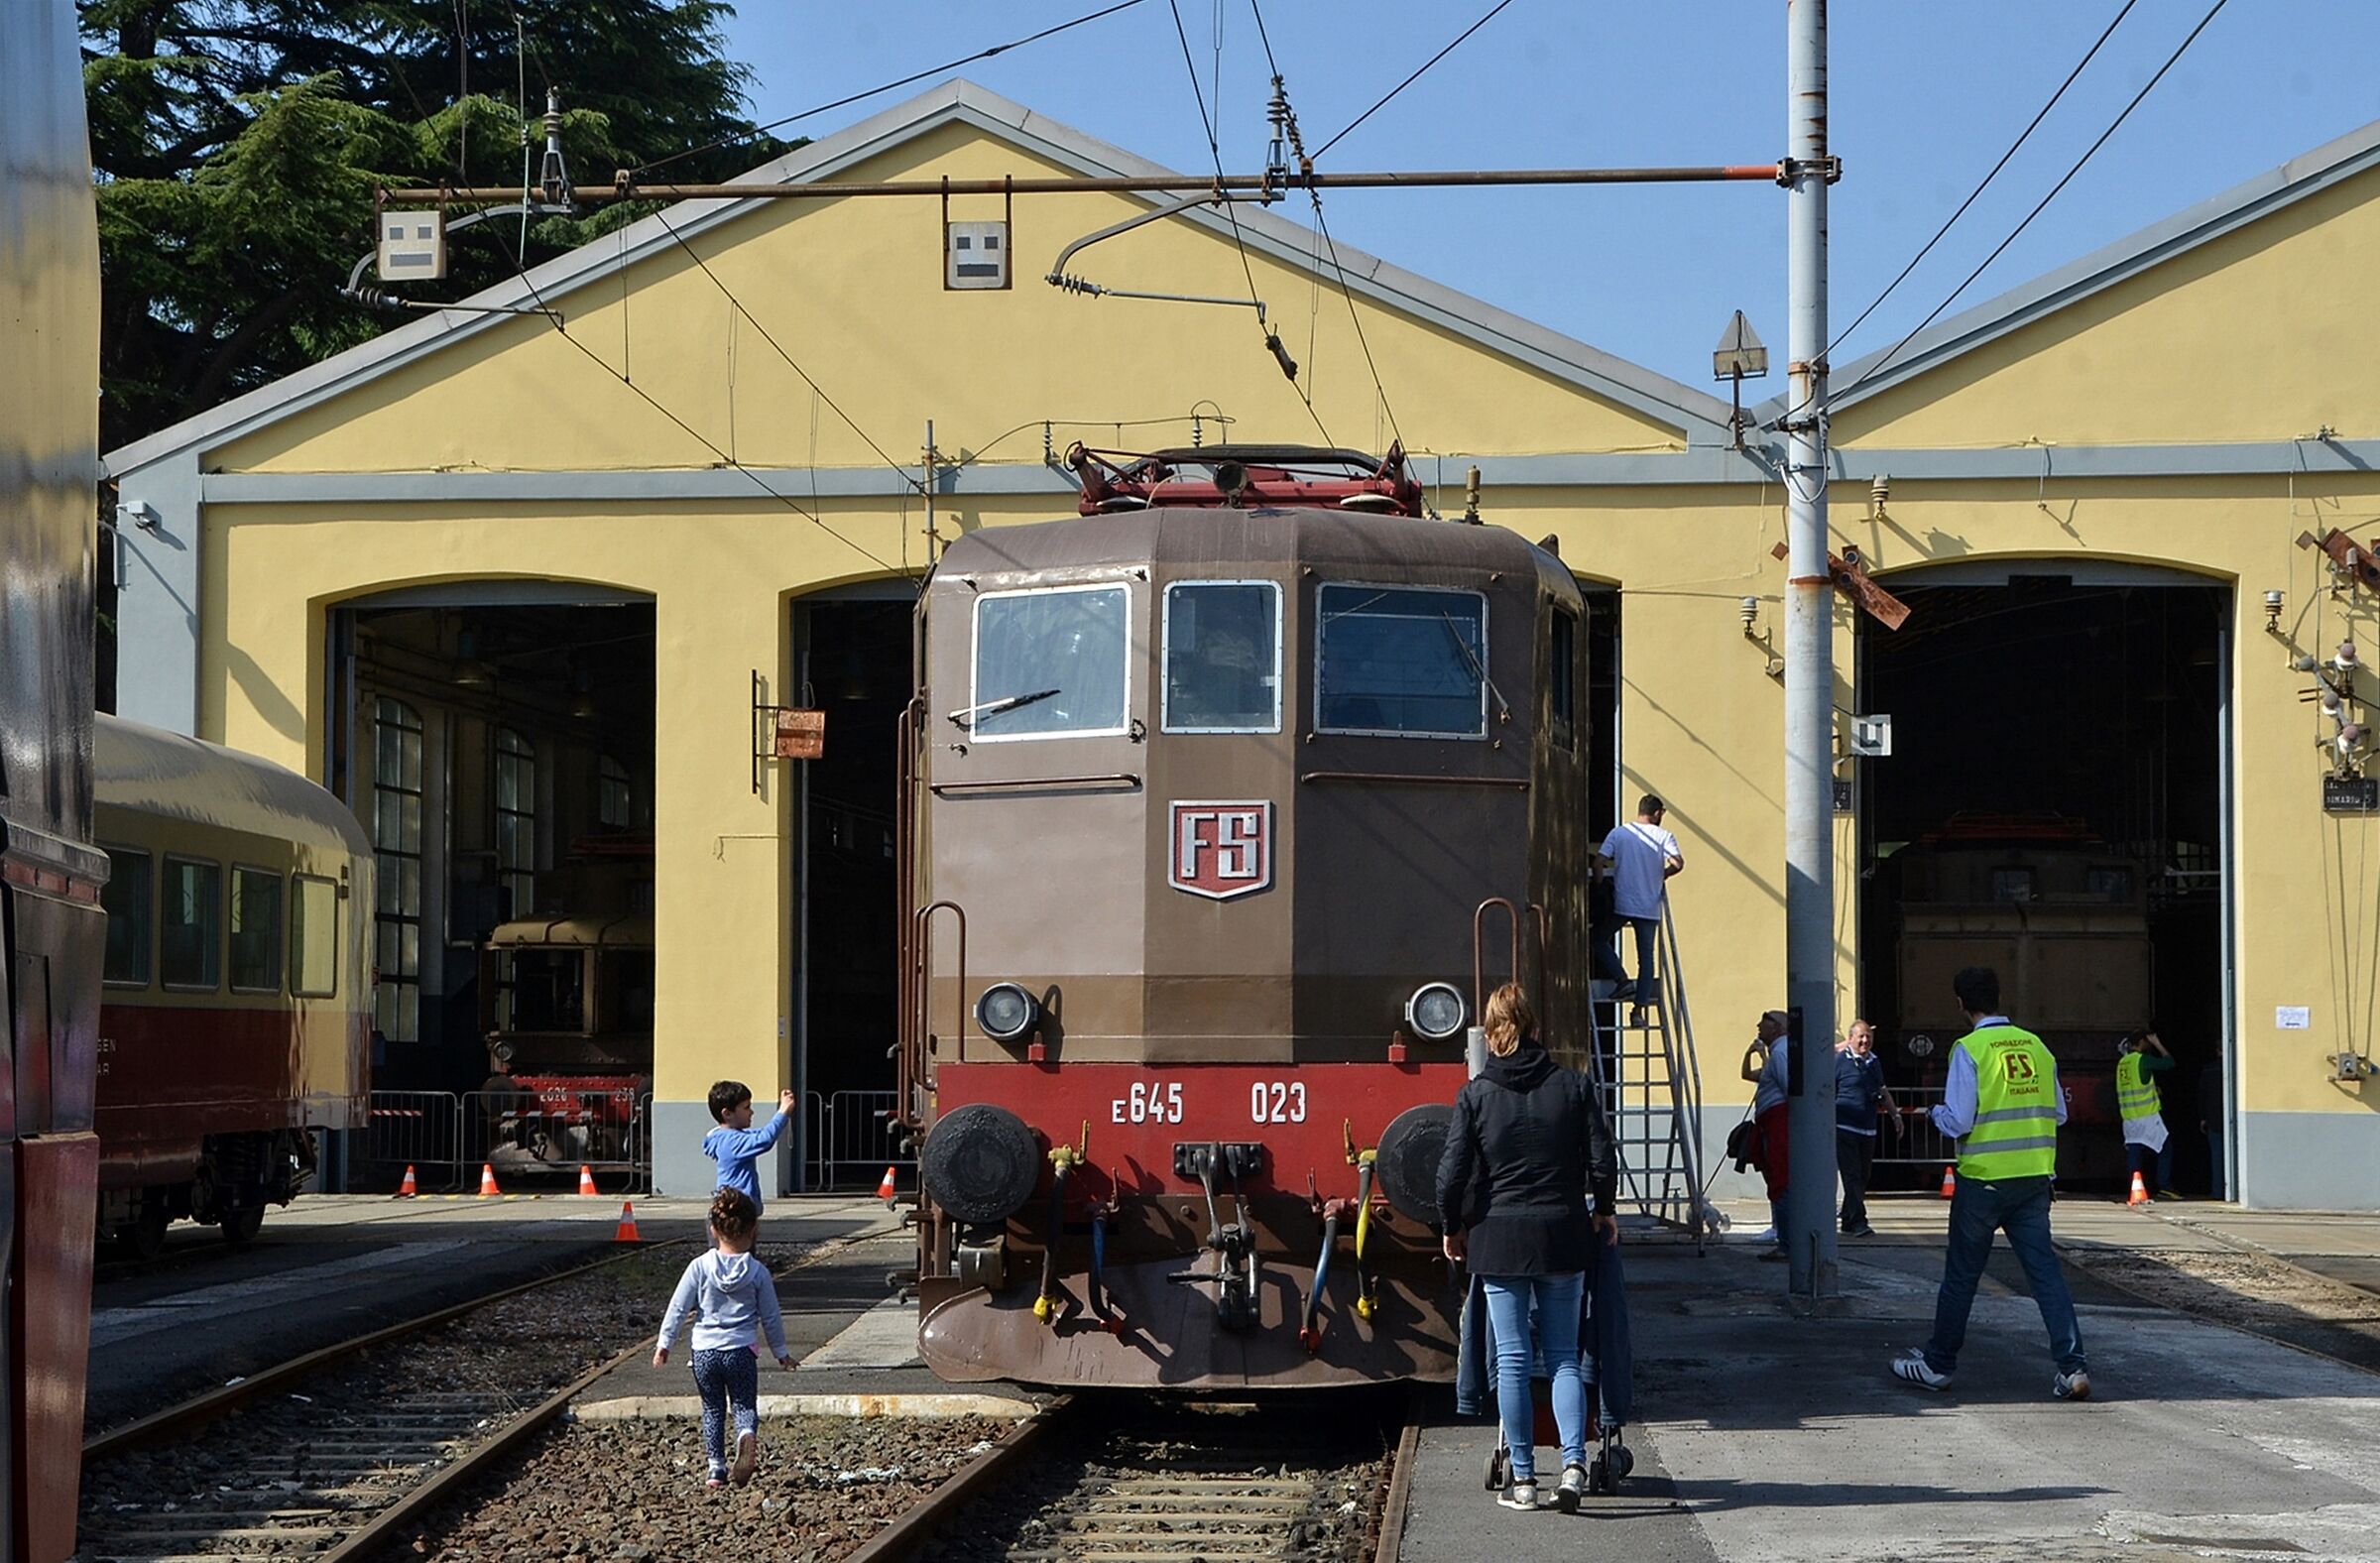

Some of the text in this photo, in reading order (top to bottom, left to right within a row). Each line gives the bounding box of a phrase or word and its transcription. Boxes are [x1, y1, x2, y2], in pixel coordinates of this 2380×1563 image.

[1181, 812, 1256, 878] FS
[1989, 1038, 2034, 1049] FONDAZIONE
[2005, 1053, 2033, 1080] FS
[1112, 1082, 1306, 1124] E645 023
